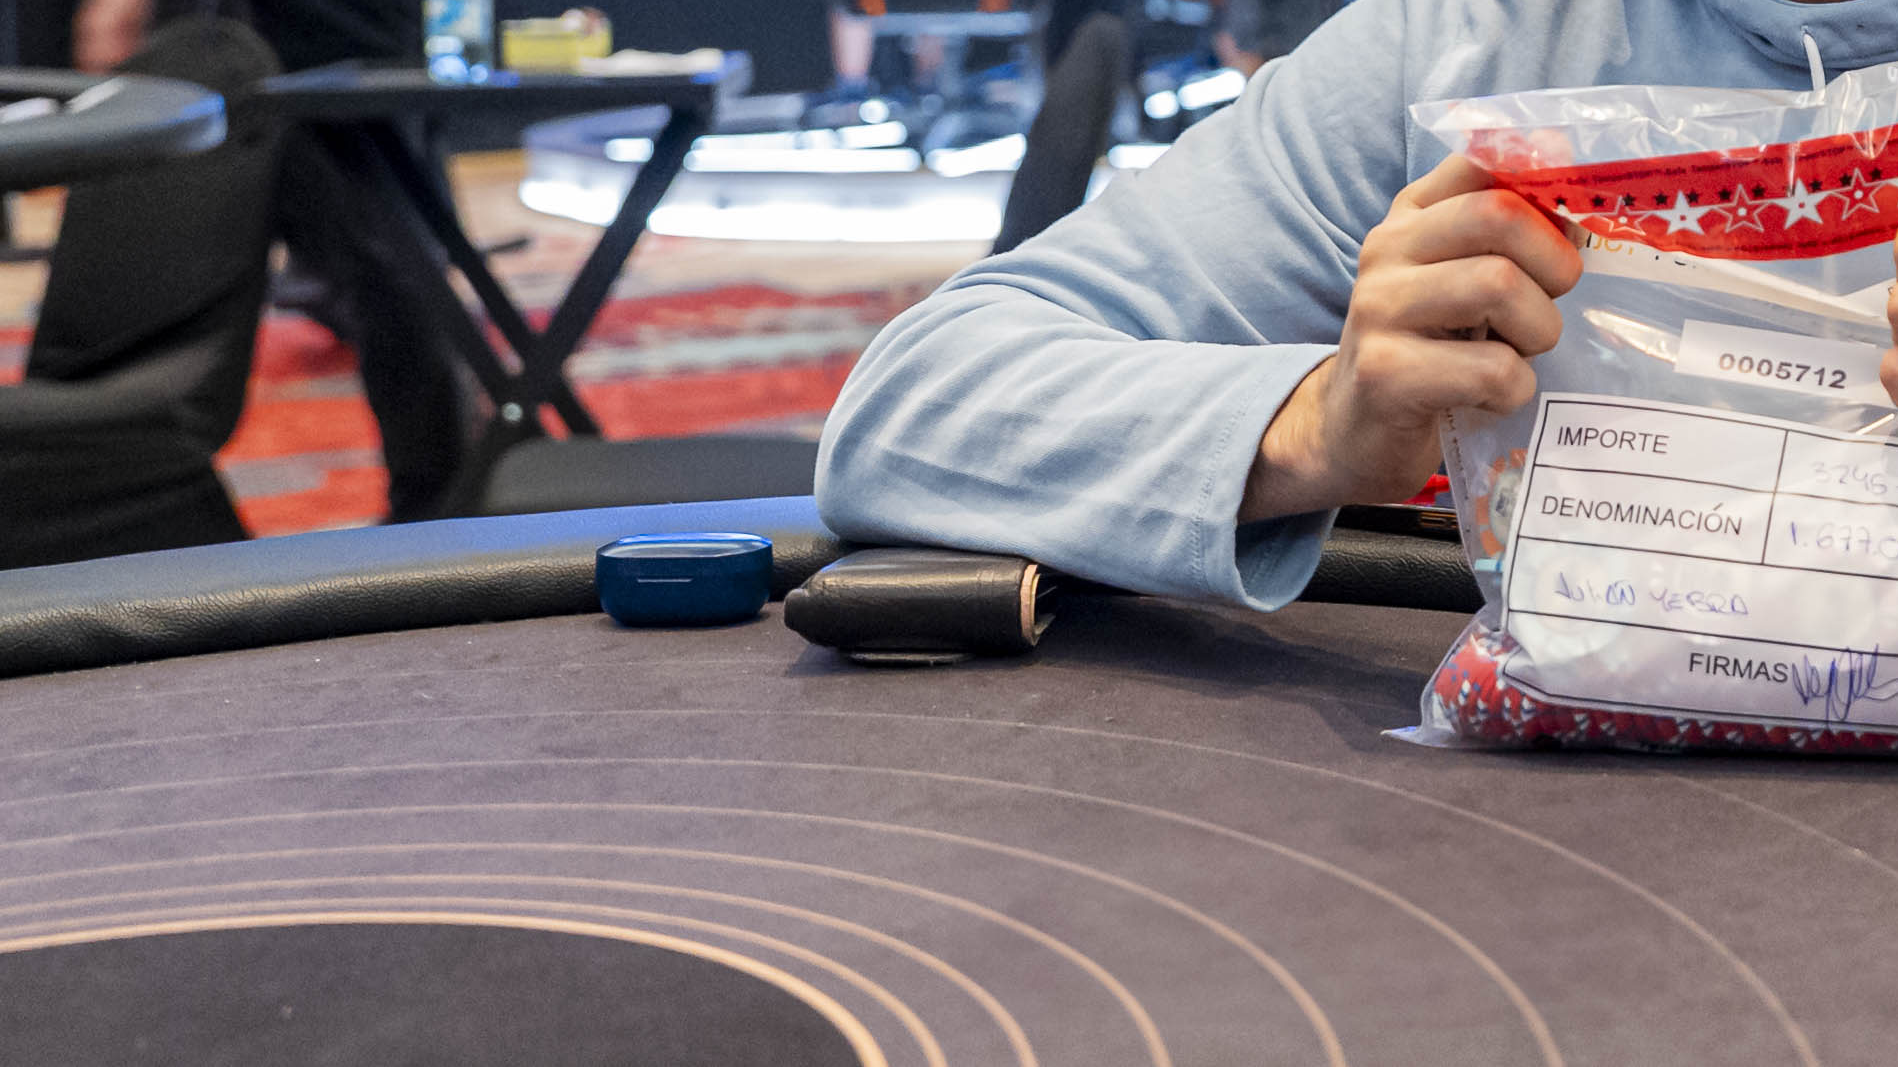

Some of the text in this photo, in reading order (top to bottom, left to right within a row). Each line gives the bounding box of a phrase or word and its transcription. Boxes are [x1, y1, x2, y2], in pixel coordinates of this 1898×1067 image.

[1719, 353, 1847, 389] 0005712
[1557, 426, 1669, 454] IMPORTE
[1541, 495, 1742, 535] DENOMINACIÓN
[1688, 652, 1788, 683] FIRMAS
